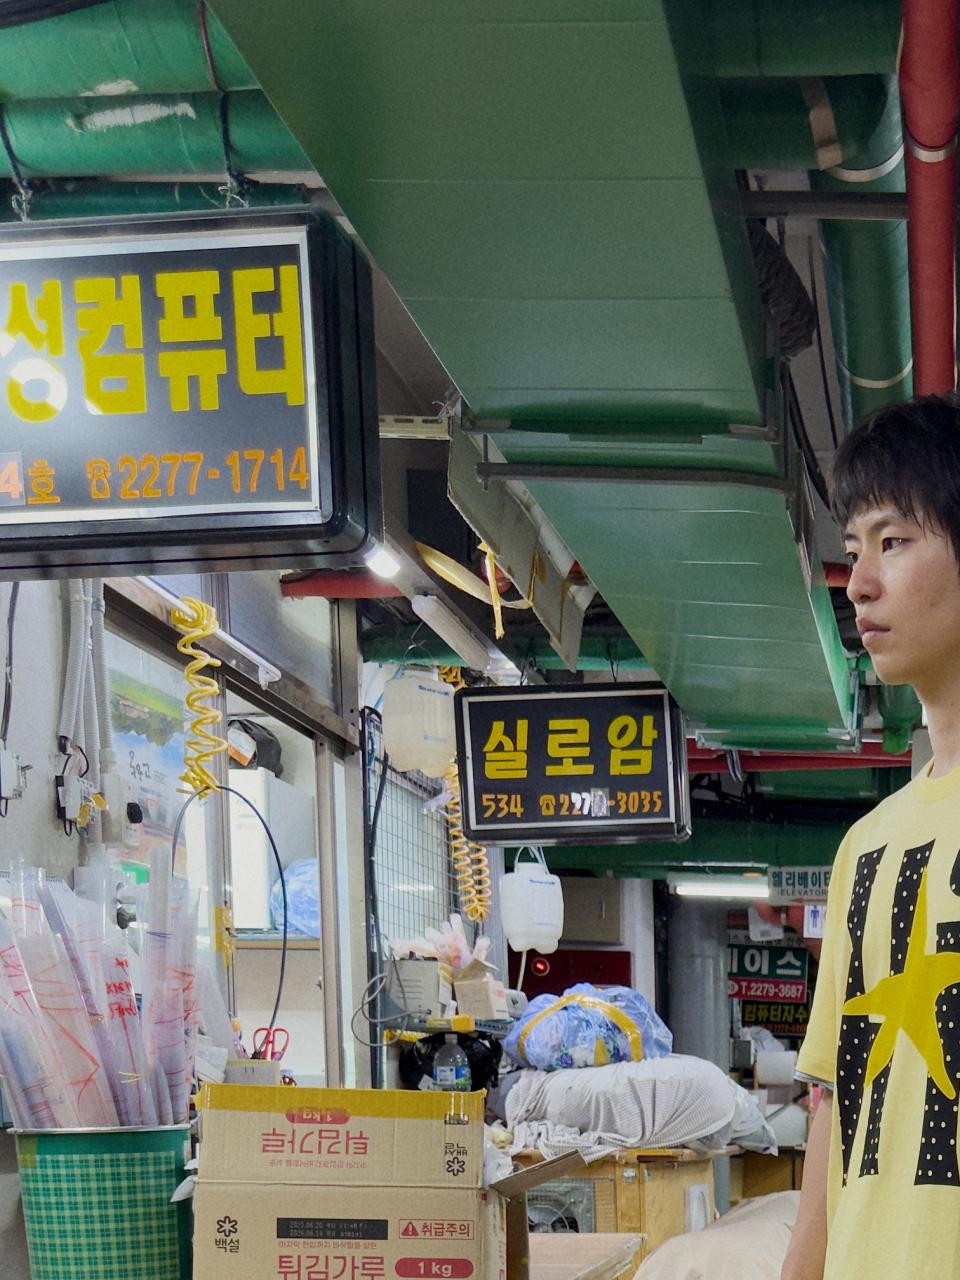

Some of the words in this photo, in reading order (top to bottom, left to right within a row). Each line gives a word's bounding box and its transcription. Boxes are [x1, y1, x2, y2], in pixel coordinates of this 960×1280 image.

[119, 447, 310, 499] 2277-1714
[482, 714, 658, 780] 실로암
[482, 793, 524, 818] 534
[261, 1127, 370, 1157] 튀김가루
[444, 1142, 467, 1157] 백설
[421, 1221, 471, 1238] 취급주의
[214, 1237, 240, 1253] 백설
[431, 1260, 453, 1278] kg
